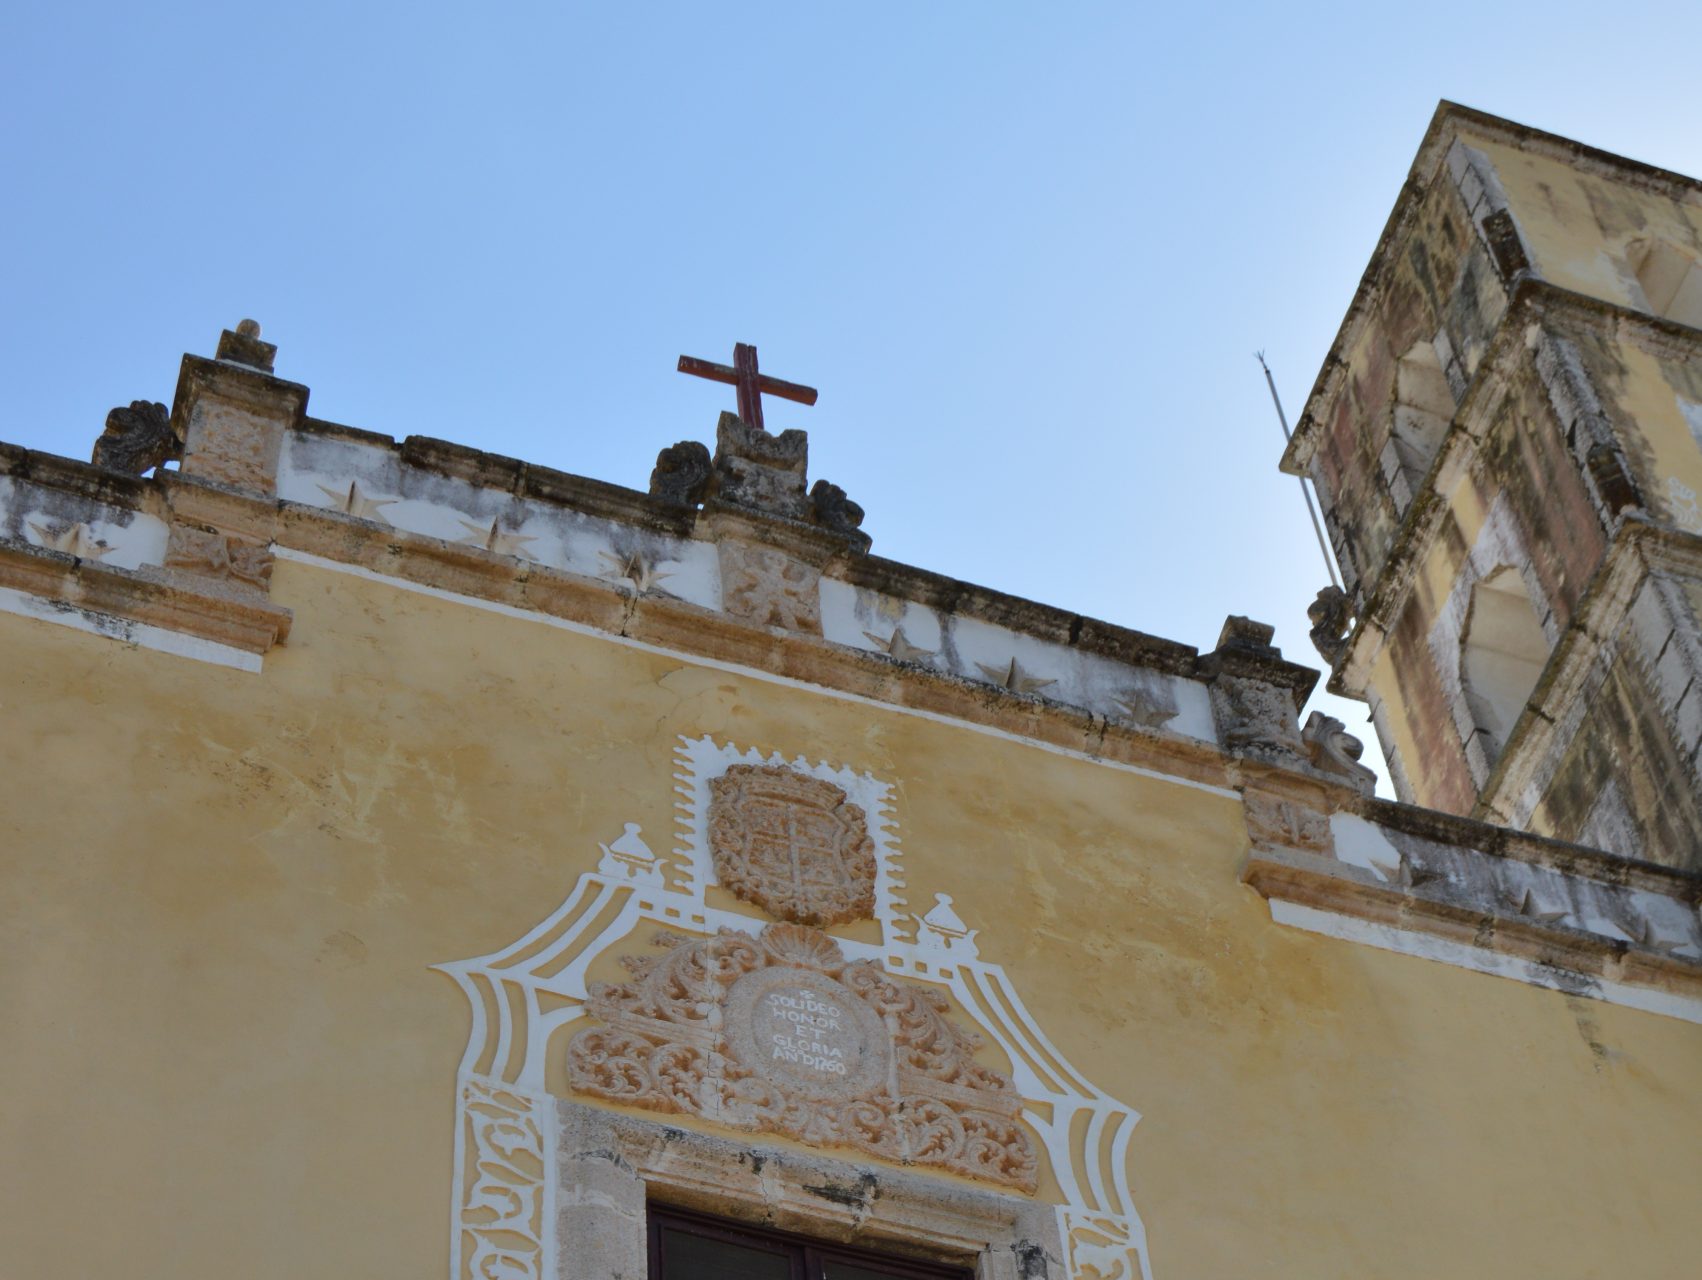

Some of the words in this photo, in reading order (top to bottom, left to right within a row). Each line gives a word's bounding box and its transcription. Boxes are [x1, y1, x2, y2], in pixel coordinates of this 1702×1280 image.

[772, 1007, 841, 1032] HONOR
[795, 1024, 827, 1040] ET
[773, 1034, 842, 1059] GLORIA
